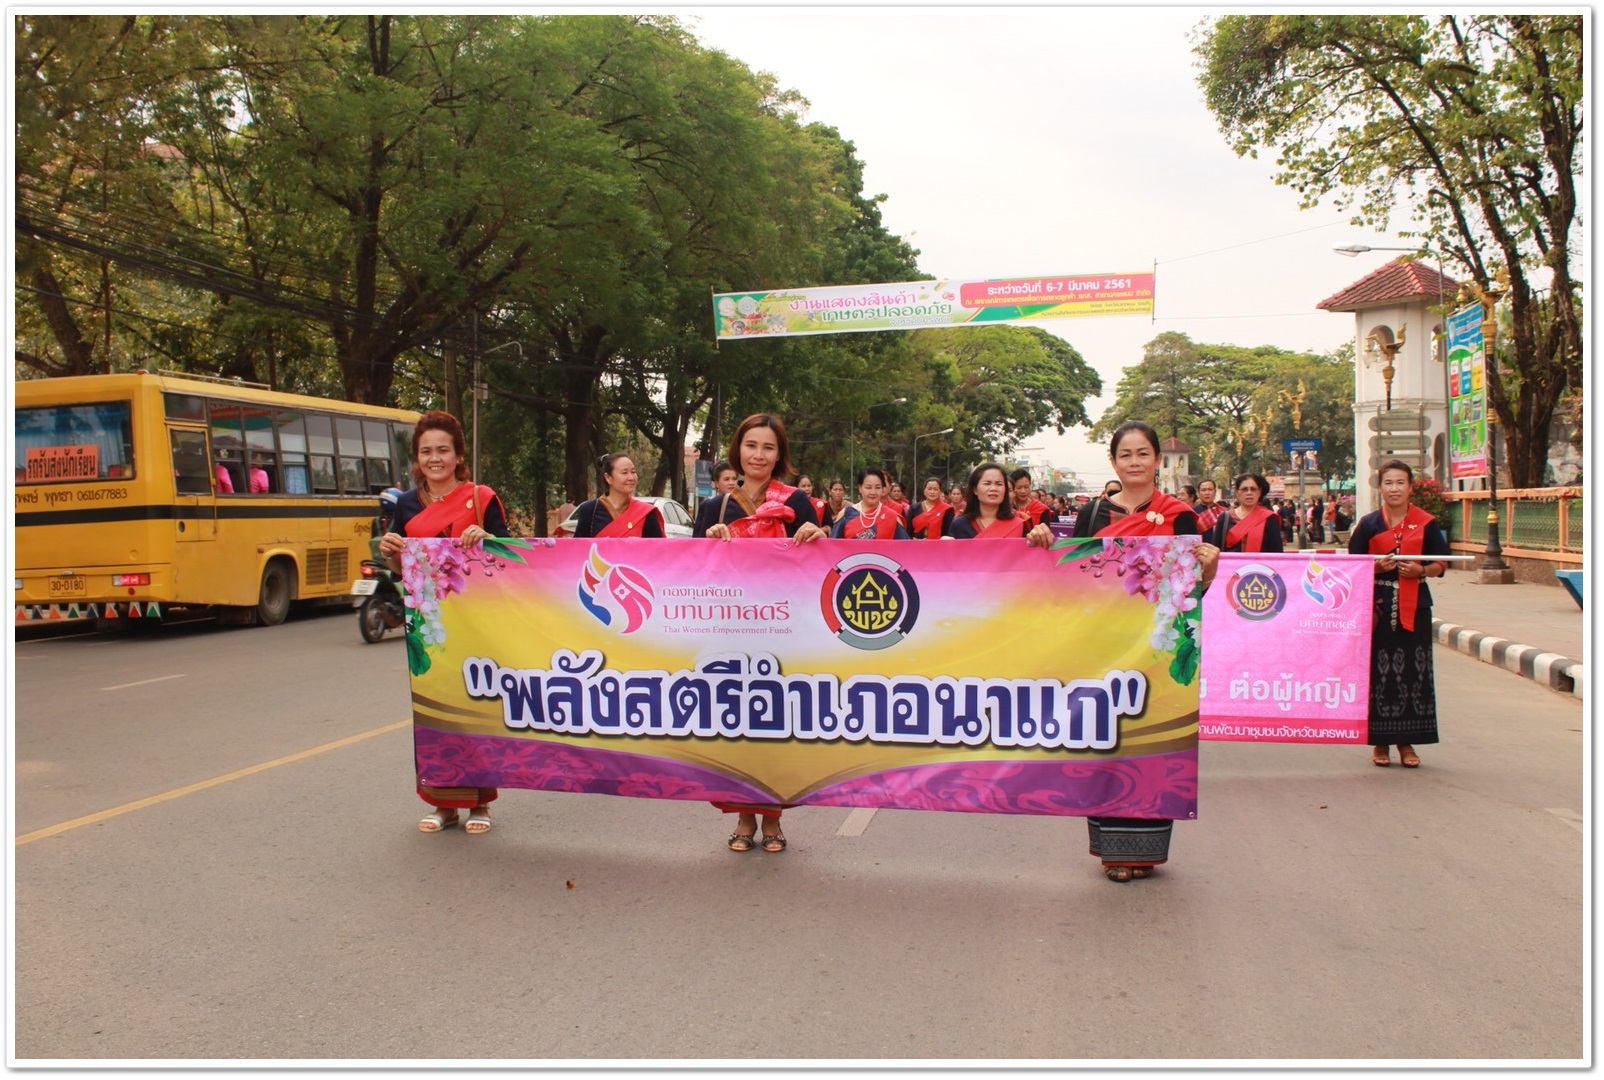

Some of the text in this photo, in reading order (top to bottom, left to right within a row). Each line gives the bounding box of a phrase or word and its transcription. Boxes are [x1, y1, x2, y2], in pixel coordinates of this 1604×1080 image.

[987, 278, 1131, 295] ระหว่างวันที่ 6-7 มีนาคม 2561
[789, 291, 917, 311] งานแสดงสินค้า
[822, 303, 952, 322] เกษตรปลอดภัย
[27, 448, 96, 479] รถรับส่งนักเรียน
[77, 488, 128, 501] 0611677883
[662, 586, 743, 600] กองทุนพัฒนา
[663, 600, 790, 620] บทบาทสตรี
[663, 625, 680, 633] Thai
[682, 626, 710, 634] Women
[712, 626, 767, 635] Empowerment
[470, 655, 1139, 742] "พลังสตรีอำเภอนาแก"
[1229, 671, 1356, 712] ต่อผู้หญิง
[1198, 722, 1360, 740] านพัฒนาชุมชนจังหวัดนครพนม
